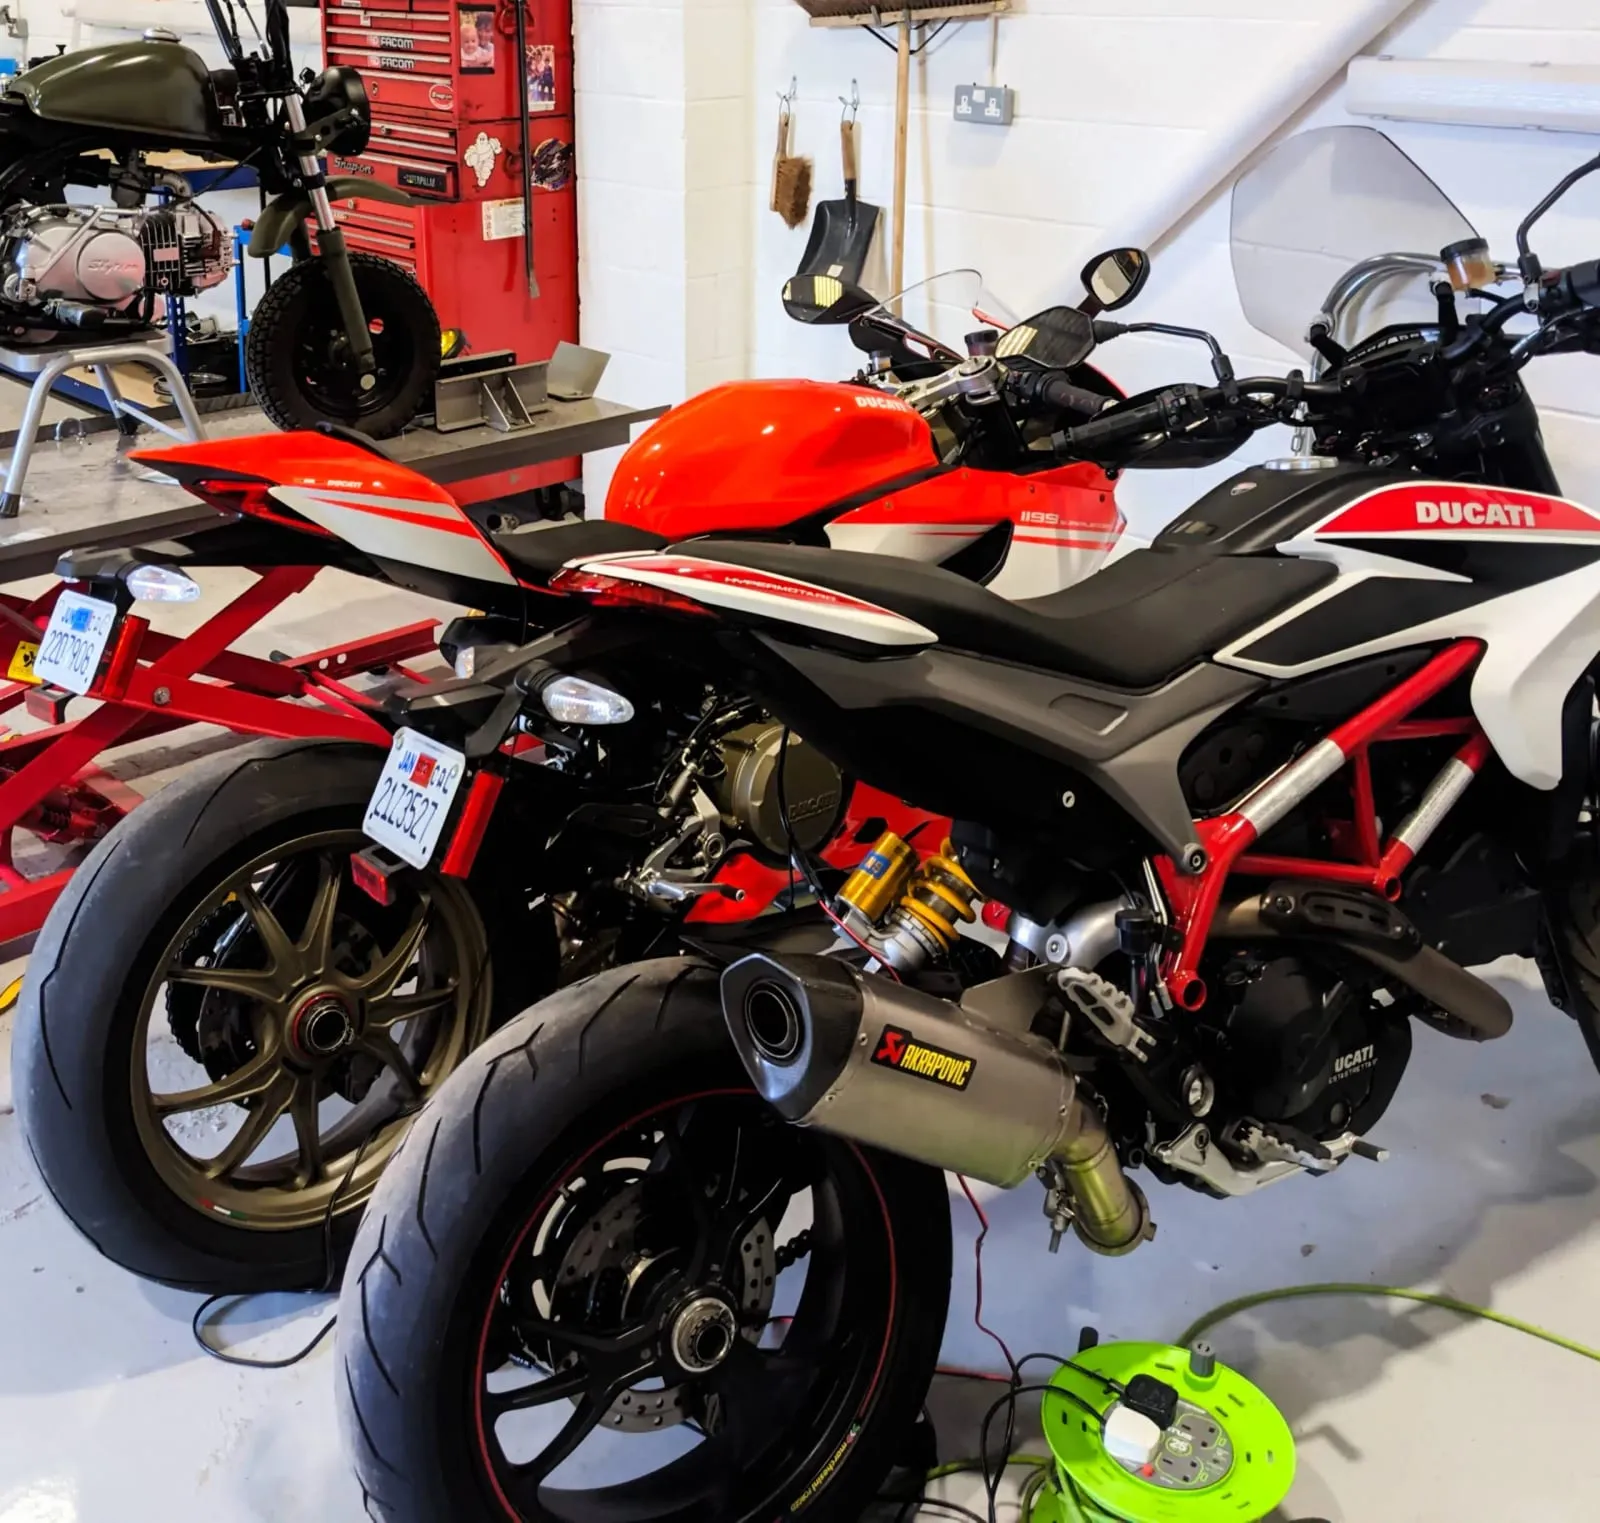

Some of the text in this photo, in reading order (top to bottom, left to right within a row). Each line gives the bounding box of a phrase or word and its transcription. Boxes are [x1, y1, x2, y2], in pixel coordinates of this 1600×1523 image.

[381, 37, 413, 49] FACOM
[381, 57, 414, 69] FACOM
[1416, 501, 1536, 527] DUCATI
